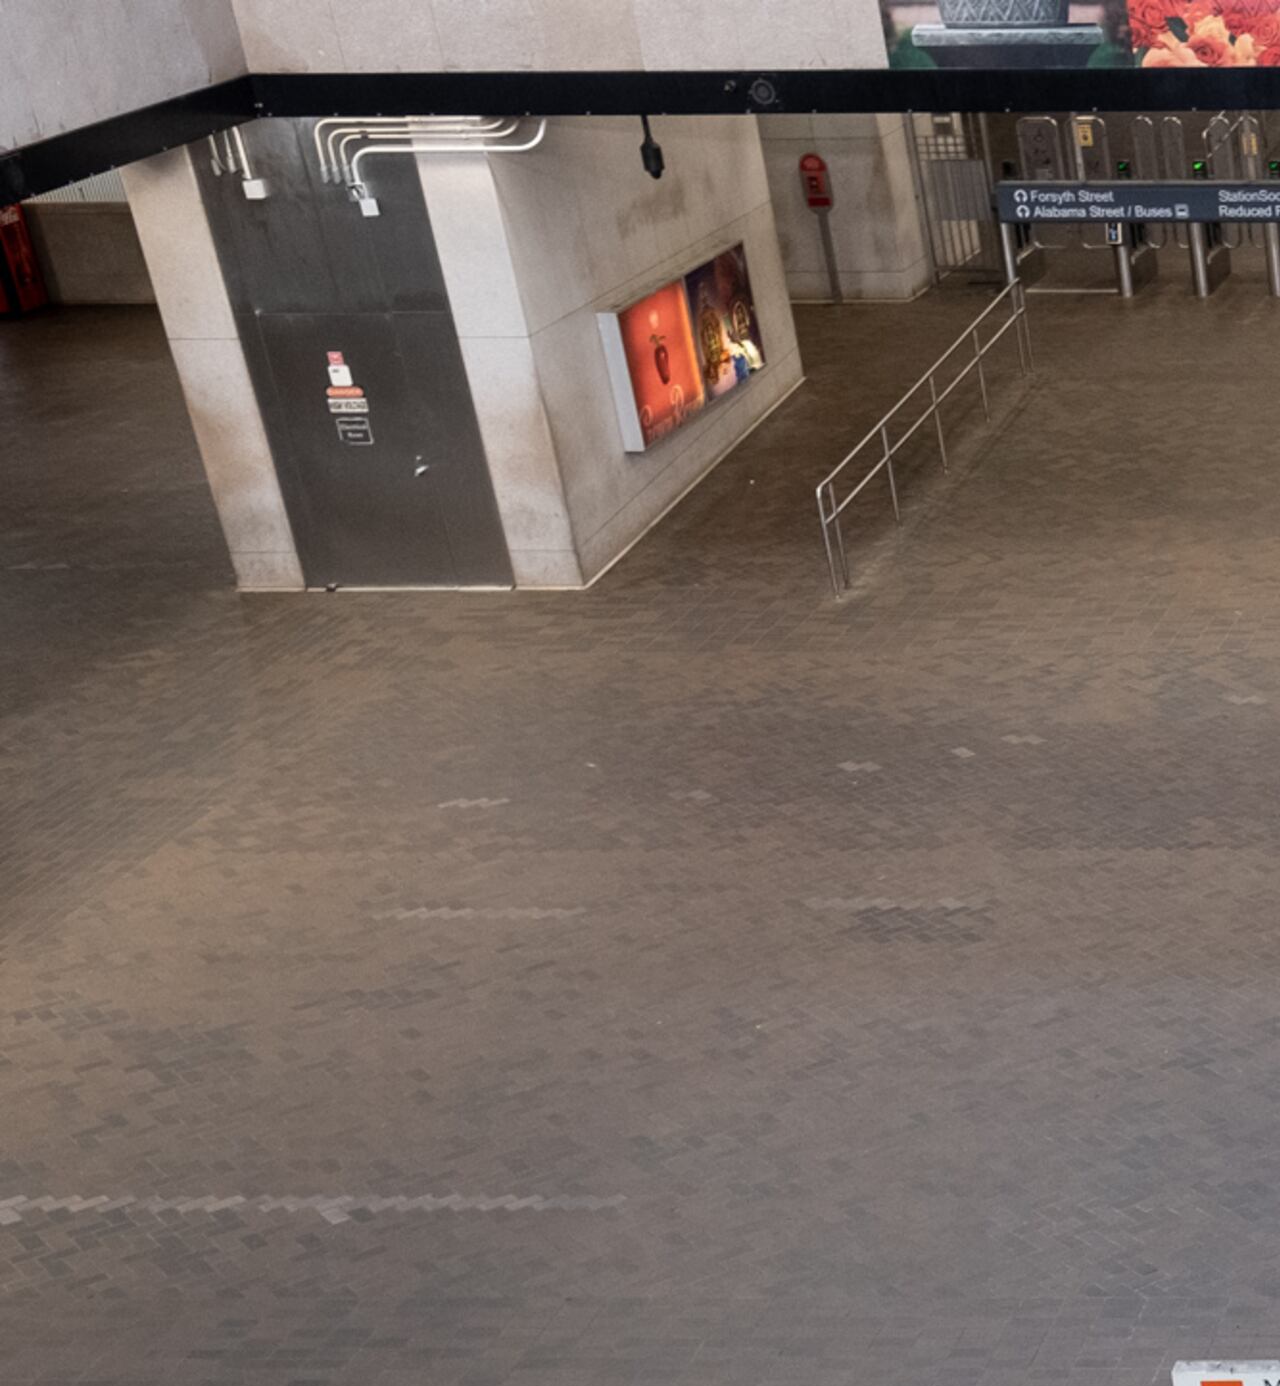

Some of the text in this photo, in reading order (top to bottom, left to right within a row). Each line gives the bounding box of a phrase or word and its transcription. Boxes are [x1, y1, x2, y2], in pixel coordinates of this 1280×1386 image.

[1030, 189, 1114, 204] Forsyth Street
[1033, 205, 1087, 218] Alabama
[1089, 205, 1125, 218] Street
[1135, 205, 1173, 218] Buses
[1218, 204, 1271, 218] Reduced
